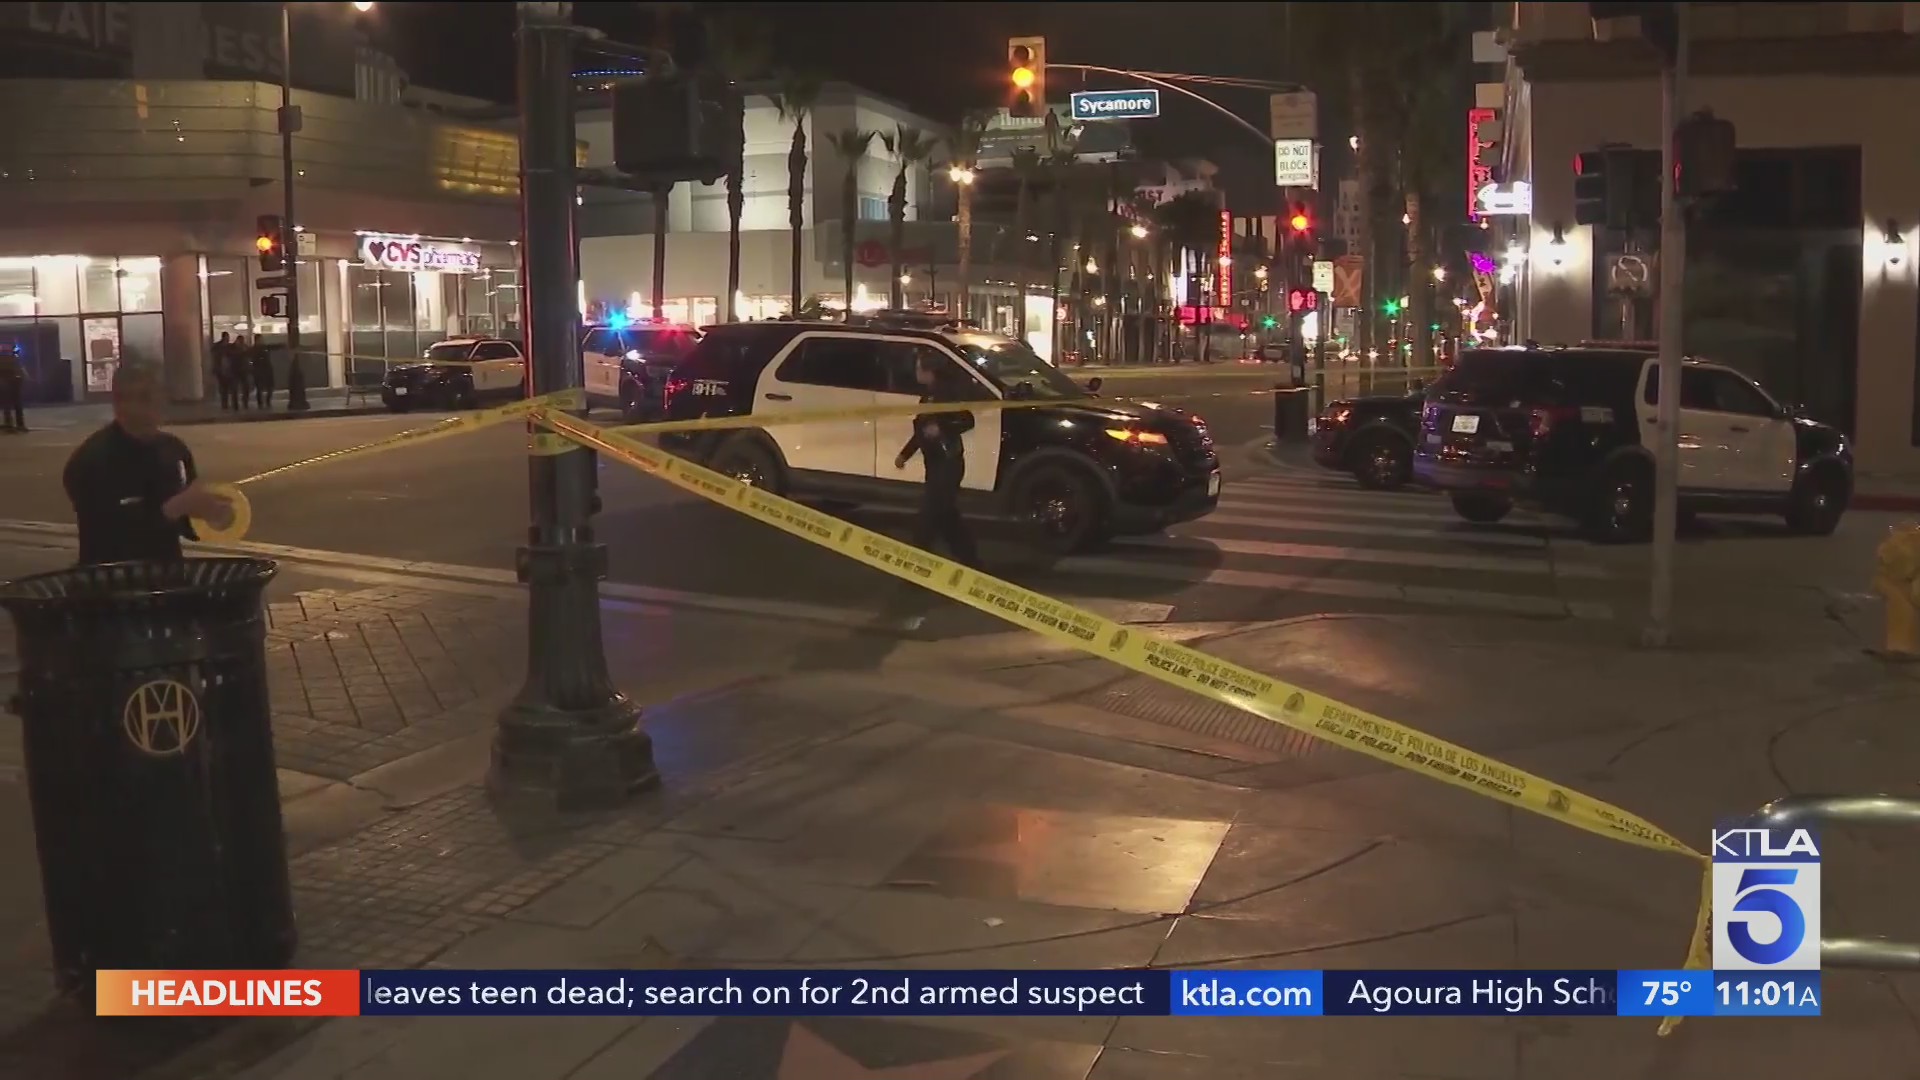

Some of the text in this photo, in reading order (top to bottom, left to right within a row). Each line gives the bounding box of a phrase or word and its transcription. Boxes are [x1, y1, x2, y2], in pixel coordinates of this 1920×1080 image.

[1079, 97, 1152, 115] Sycamore
[1279, 145, 1309, 156] DO NOT
[1279, 160, 1309, 171] BLOCK
[387, 241, 422, 262] CVS
[1144, 653, 1172, 671] POLICE
[1322, 705, 1528, 790] DEPARTAMENTO DE POLICIA DE LOS ANGELES
